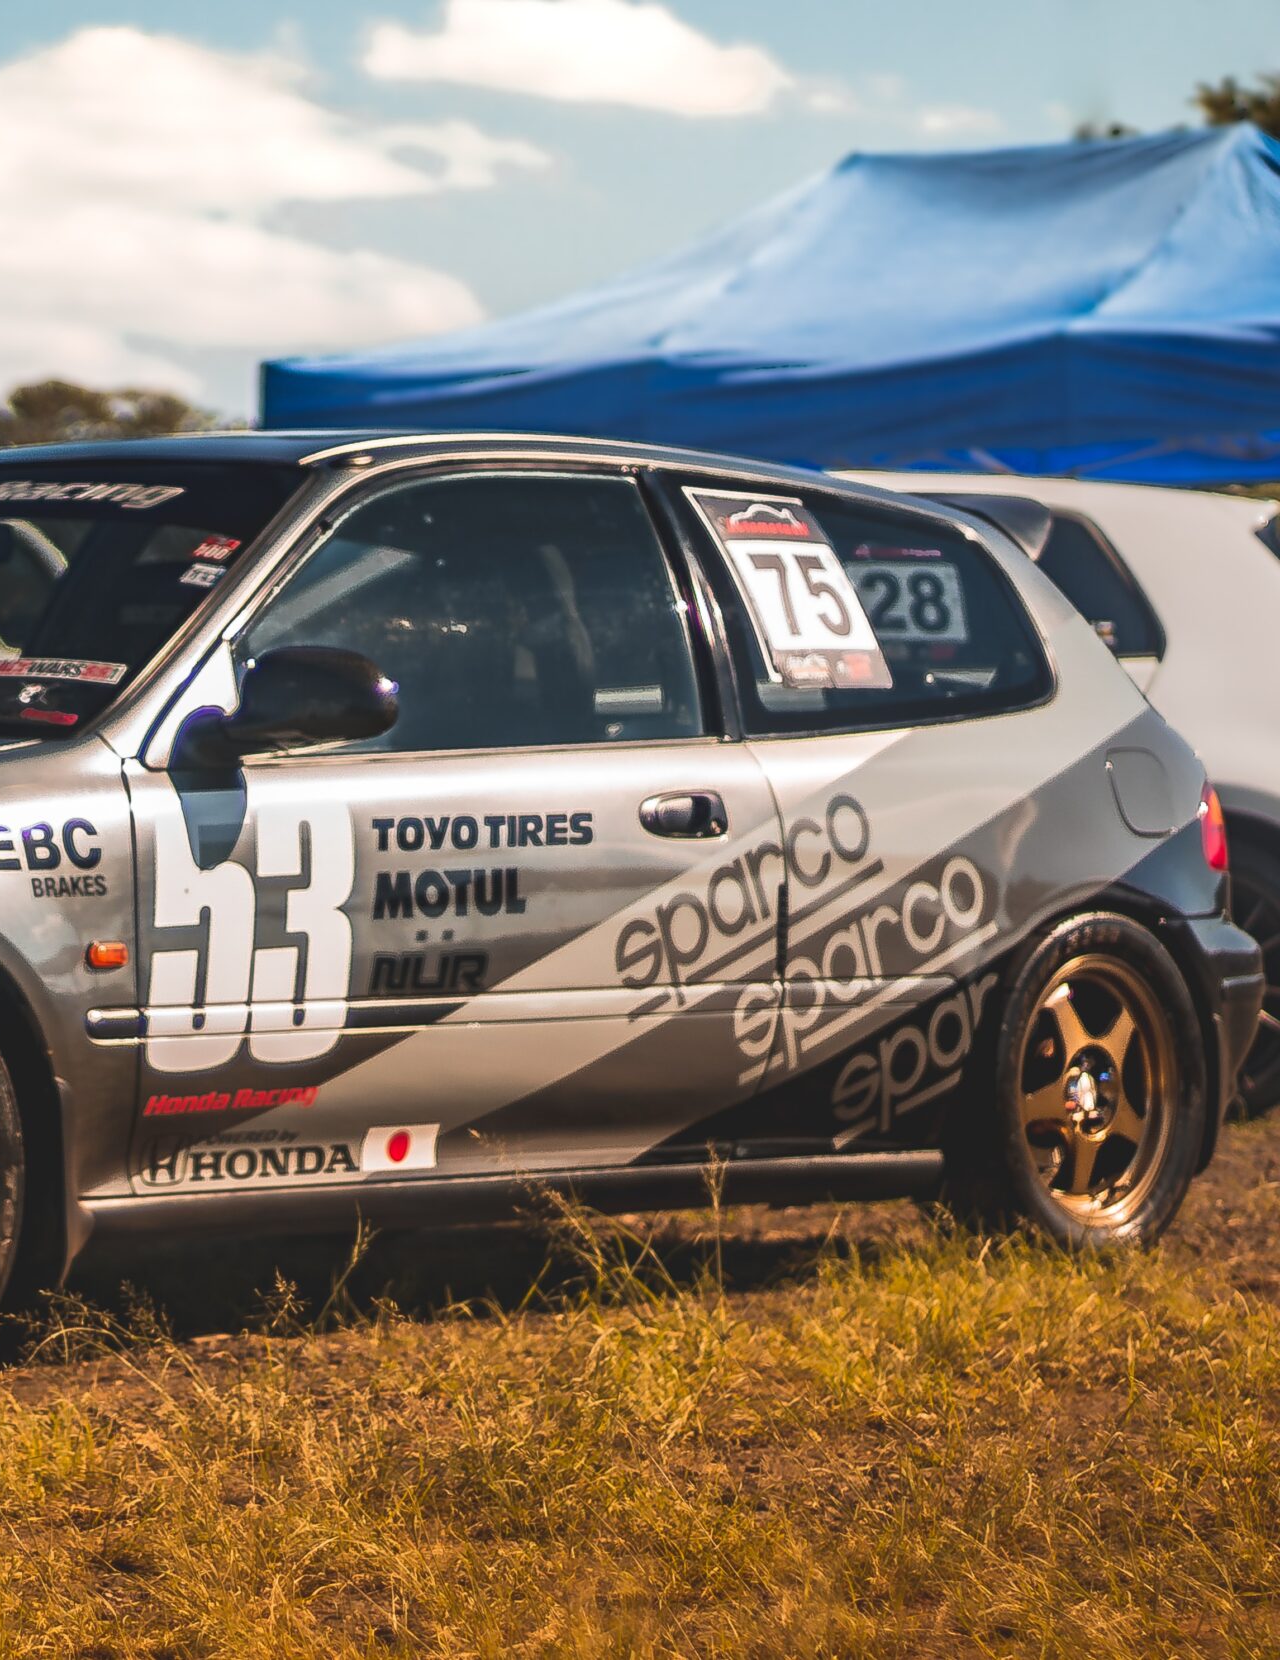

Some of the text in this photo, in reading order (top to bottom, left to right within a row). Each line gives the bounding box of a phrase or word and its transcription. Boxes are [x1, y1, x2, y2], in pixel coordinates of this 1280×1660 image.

[748, 553, 852, 636] 75
[861, 568, 951, 632] 28
[372, 812, 594, 852] TOYO TIRES
[31, 875, 108, 898] BRAKES
[373, 866, 528, 920] MOTUL
[616, 794, 871, 1007] sparco
[146, 797, 356, 1073] 53
[733, 855, 985, 1071] sparco
[143, 1086, 319, 1116] Honda Racing
[188, 1143, 360, 1182] HONDA
